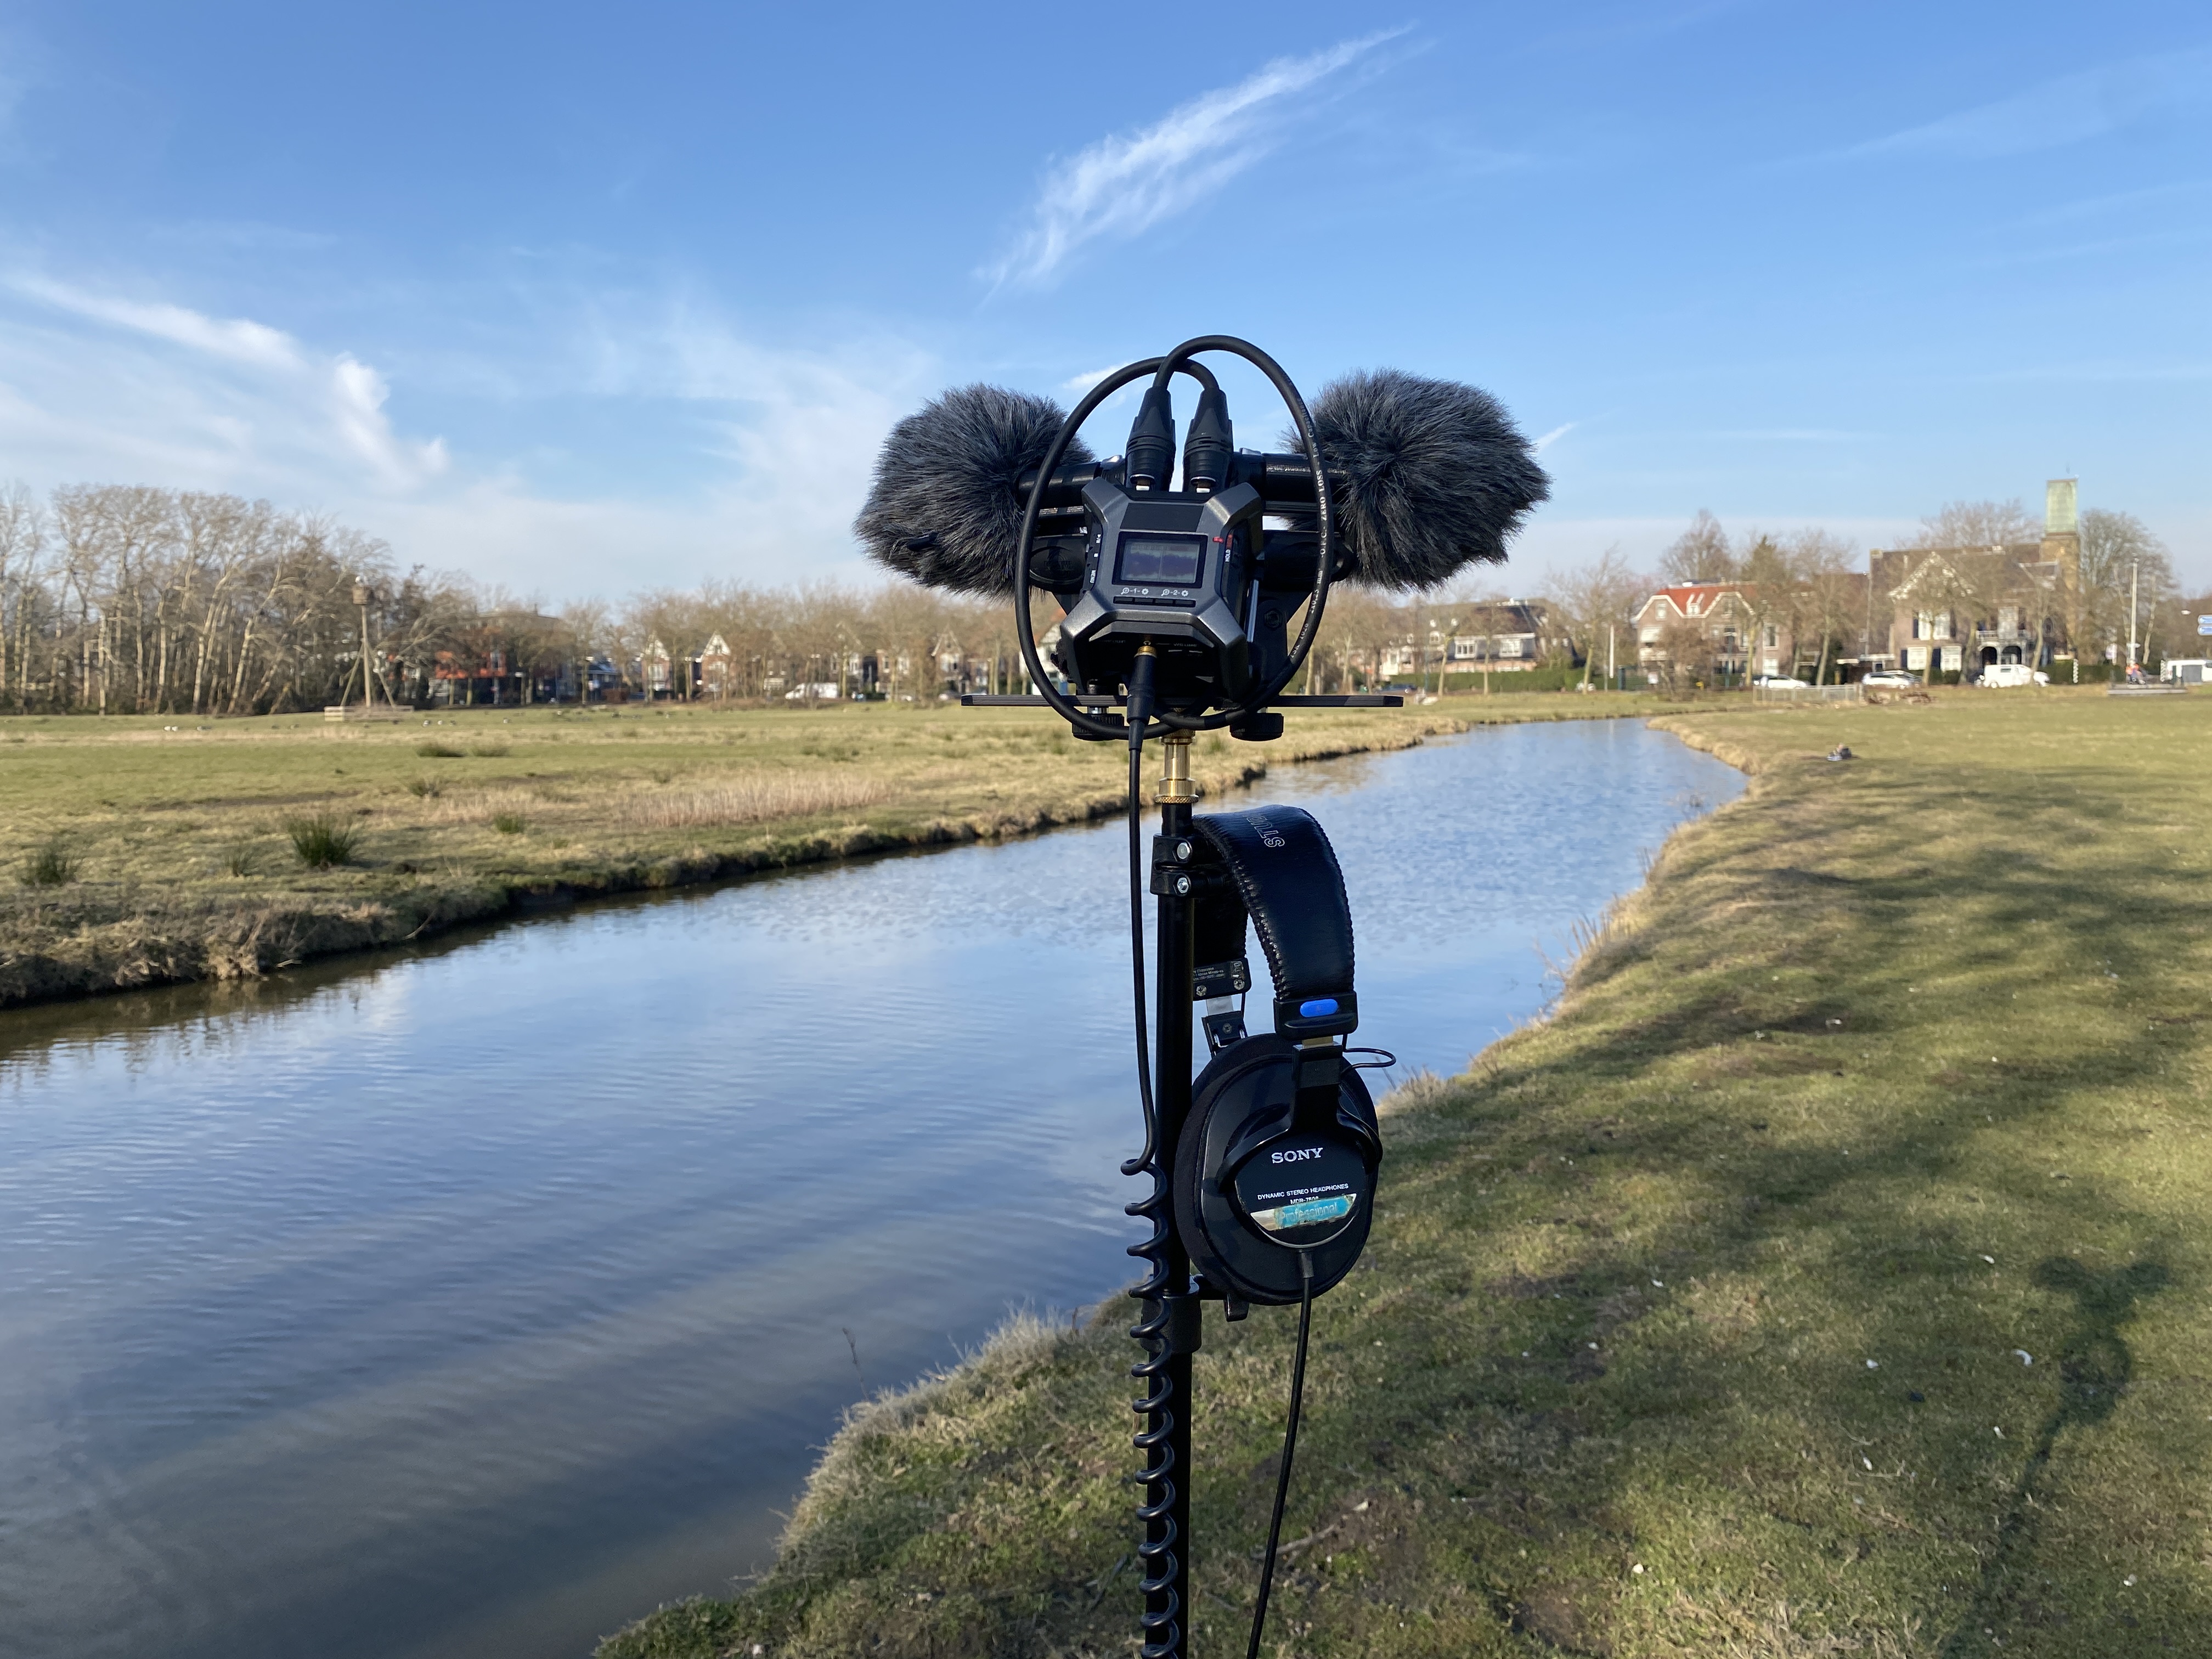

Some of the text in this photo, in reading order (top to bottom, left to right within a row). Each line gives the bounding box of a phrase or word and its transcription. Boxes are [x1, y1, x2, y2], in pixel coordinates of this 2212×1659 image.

[1316, 470, 1324, 492] LOSS
[1271, 1147, 1323, 1164] SONY
[1257, 1192, 1285, 1200] DYNAMIC
[1310, 1183, 1349, 1193] HEADPHONES
[1282, 1202, 1338, 1222] Professional
